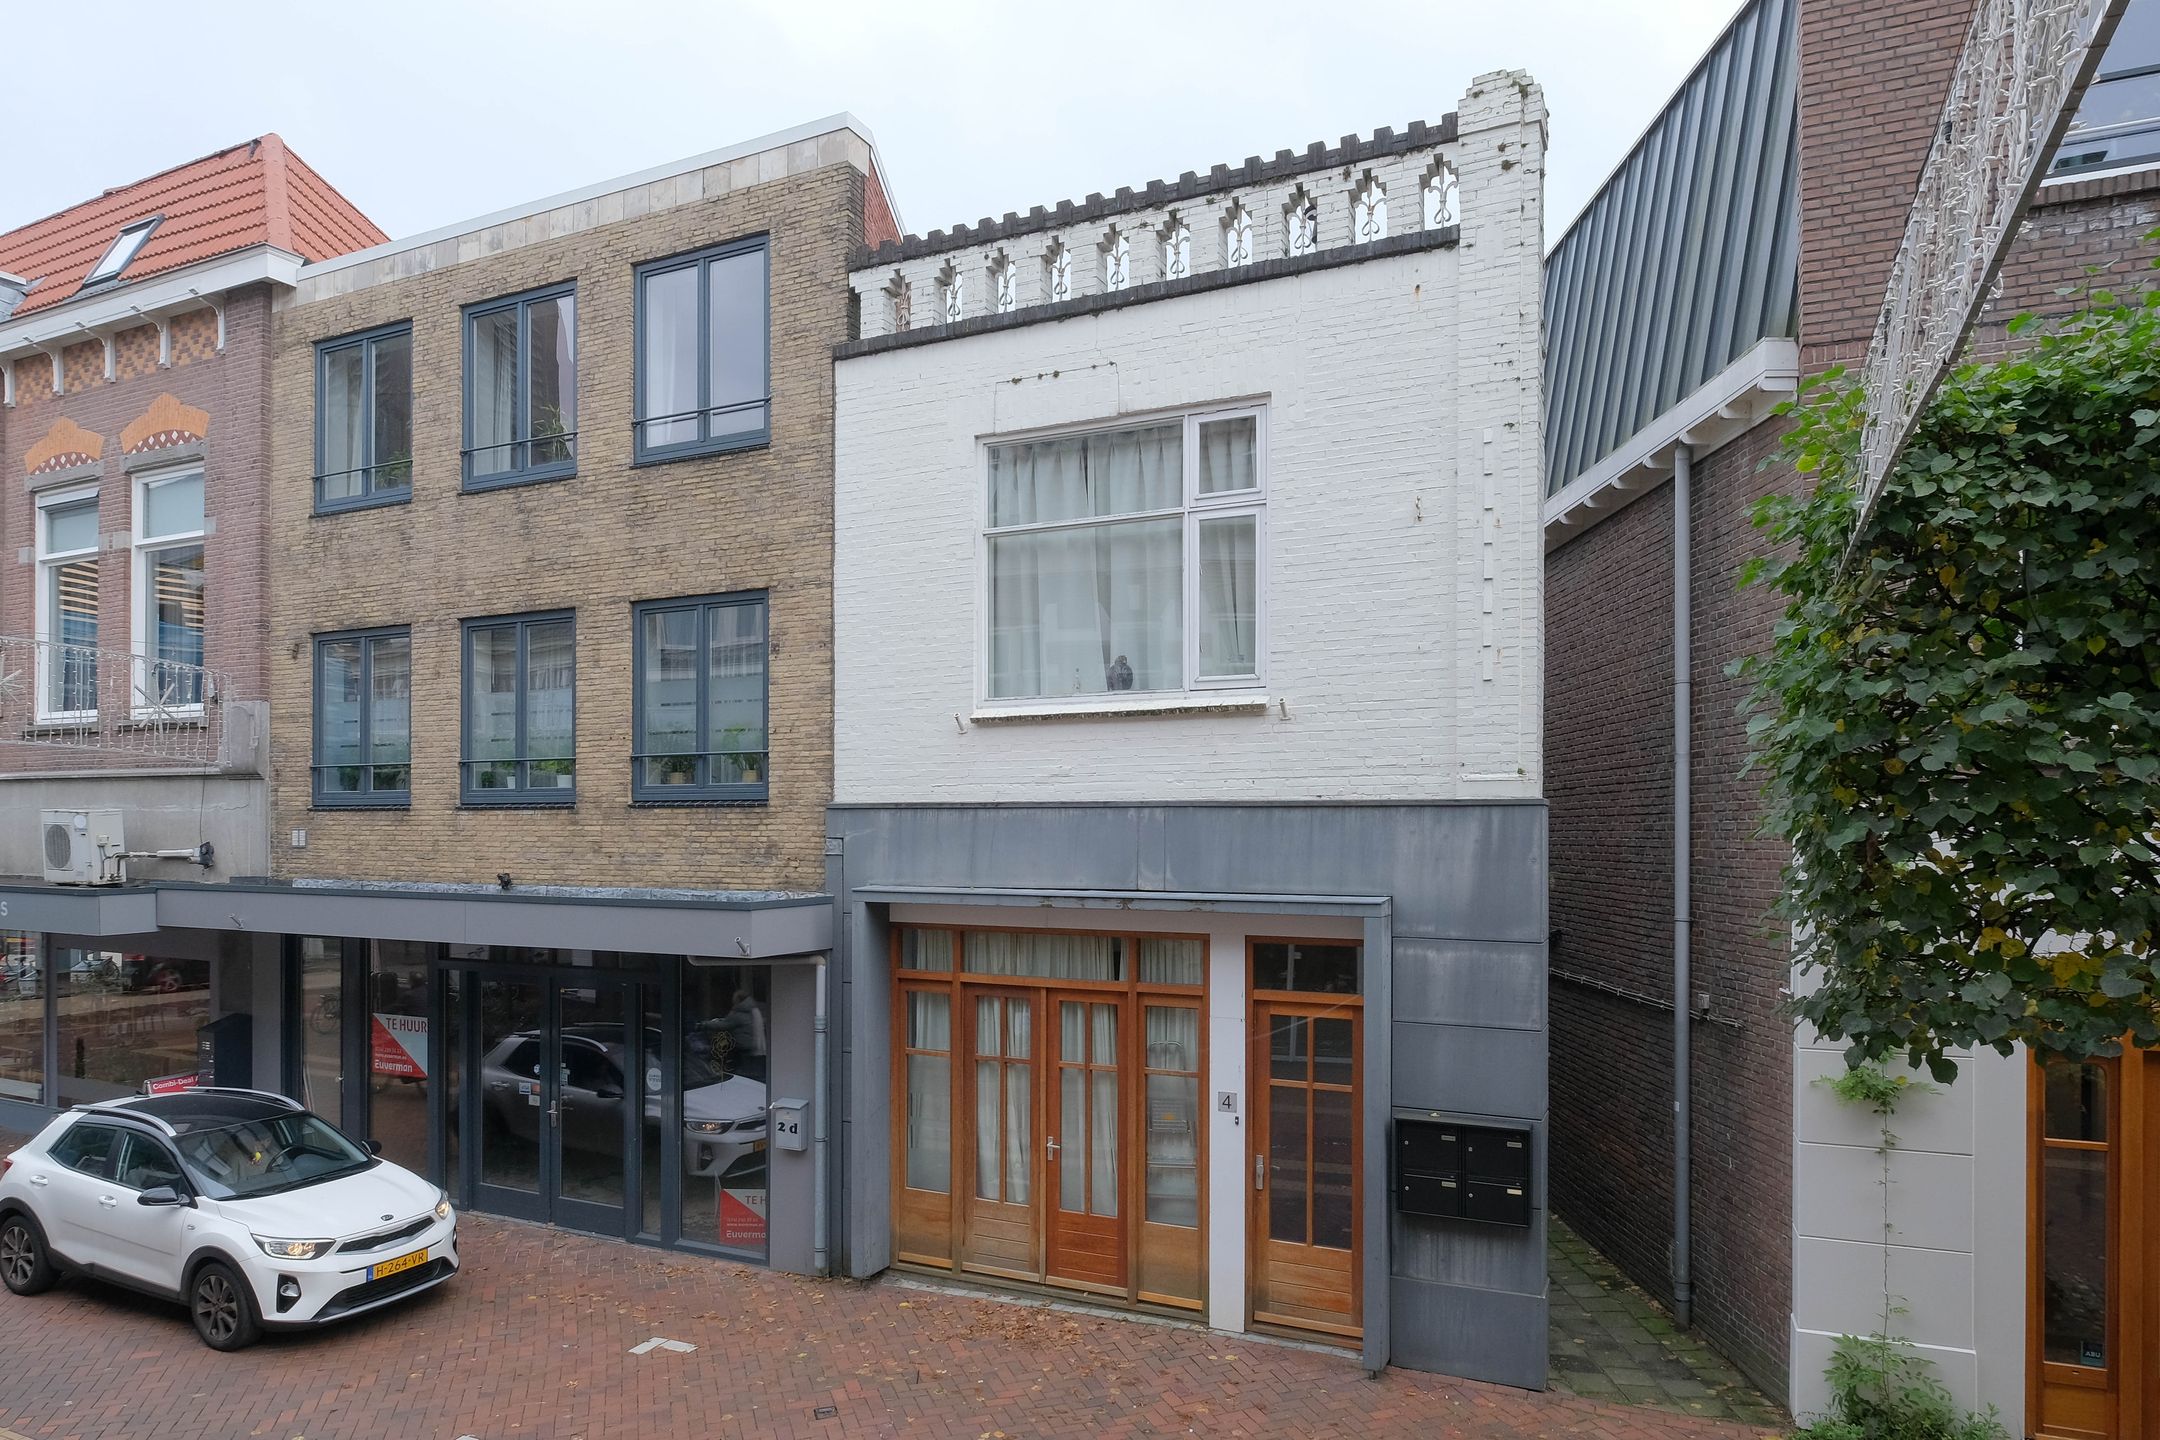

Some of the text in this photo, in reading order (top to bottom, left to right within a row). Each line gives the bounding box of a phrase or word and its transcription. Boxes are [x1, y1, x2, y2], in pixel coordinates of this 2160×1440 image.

[386, 1018, 427, 1033] TE HUUR
[153, 1076, 194, 1090] Combi-Deal
[1222, 1095, 1232, 1109] 4
[745, 1195, 757, 1205] TE
[376, 1252, 424, 1277] H-264-VR
